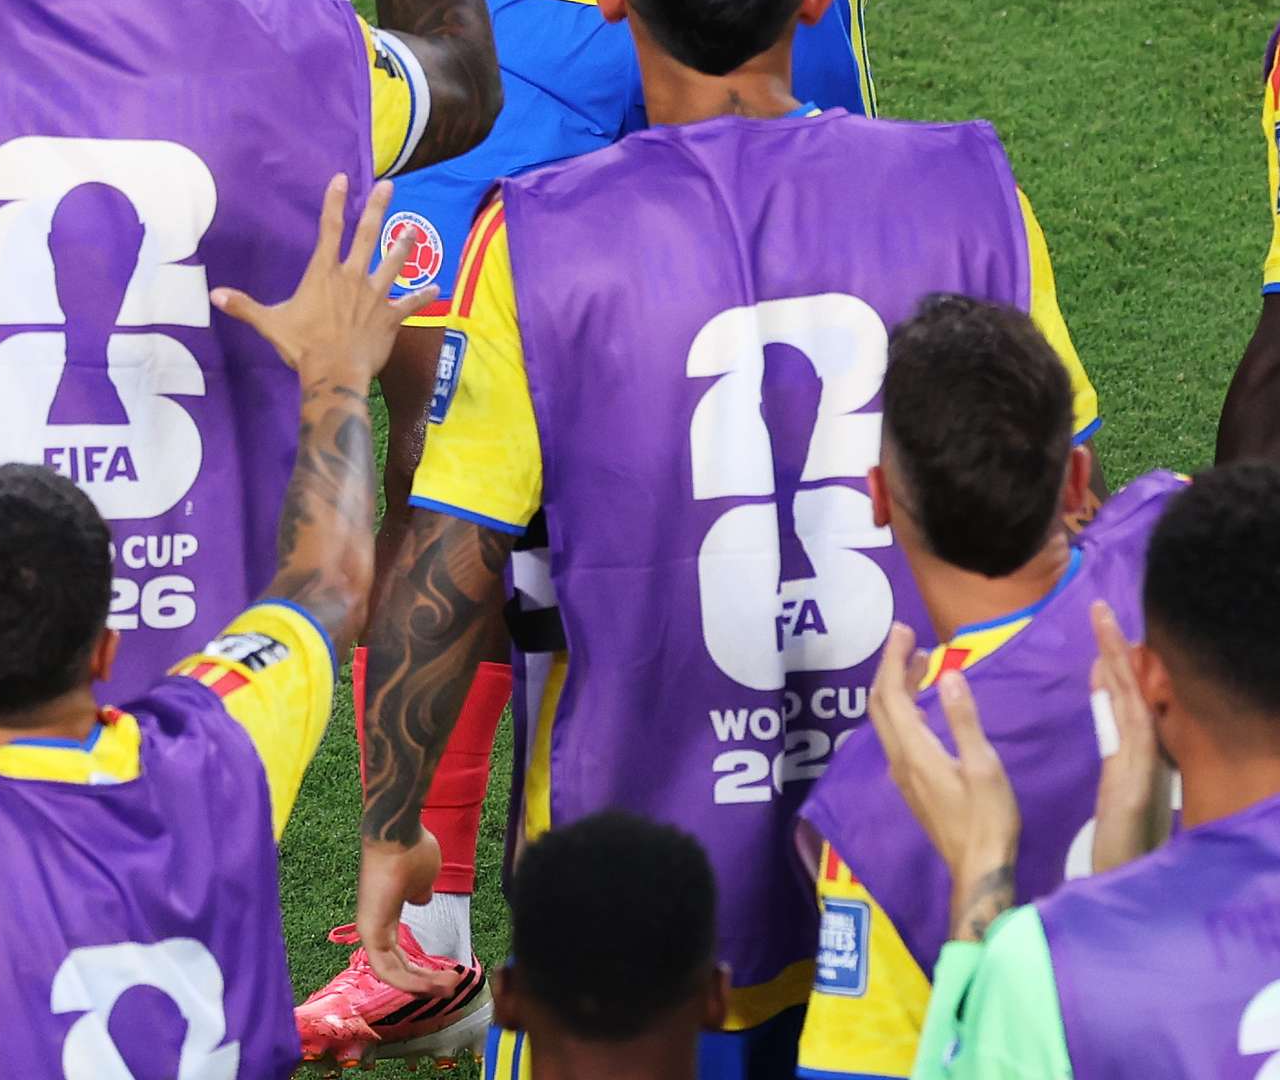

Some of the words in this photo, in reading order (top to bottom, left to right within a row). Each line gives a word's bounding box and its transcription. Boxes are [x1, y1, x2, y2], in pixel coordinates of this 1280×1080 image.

[43, 446, 139, 483] FIFA
[122, 533, 199, 570] CUP
[106, 574, 197, 630] 26
[810, 686, 867, 719] CU
